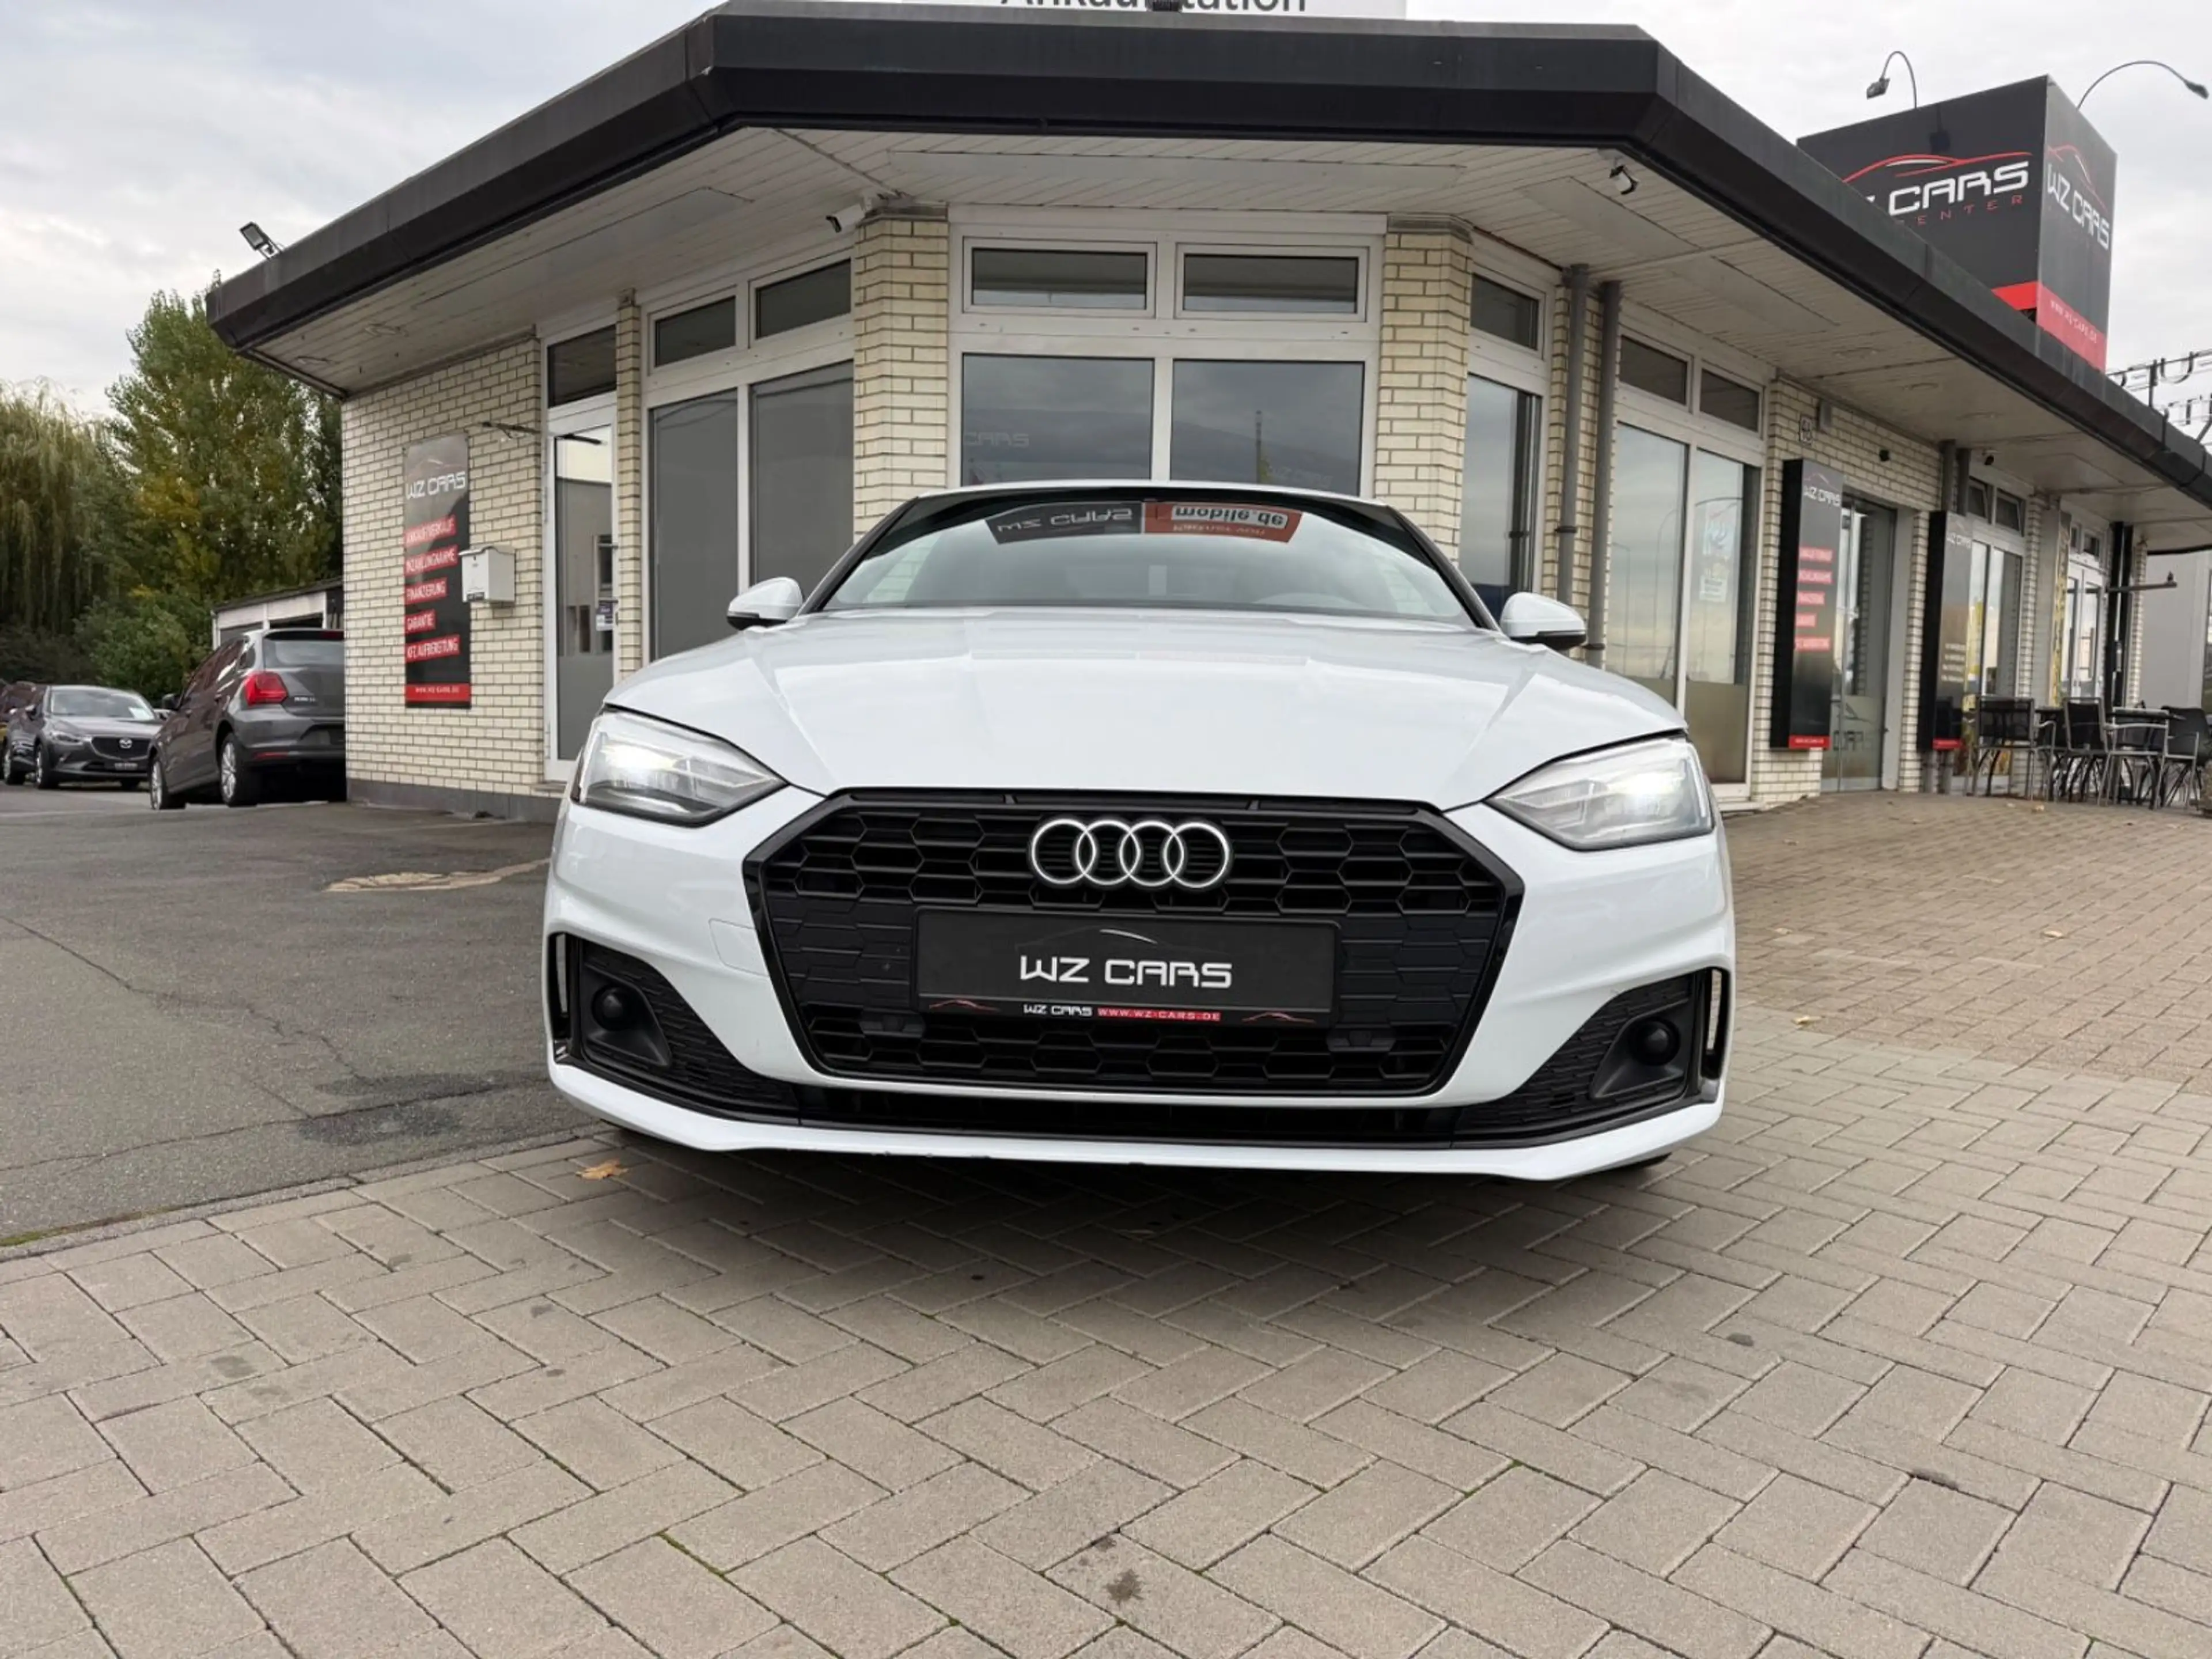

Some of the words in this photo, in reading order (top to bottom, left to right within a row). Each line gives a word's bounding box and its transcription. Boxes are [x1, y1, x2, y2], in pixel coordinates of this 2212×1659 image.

[1889, 161, 2029, 217] CARS
[1895, 194, 2024, 226] ENTER
[2047, 164, 2070, 212] WZ
[2072, 190, 2109, 251] CARS
[406, 480, 425, 499] WZ
[427, 471, 466, 496] CARS
[1020, 956, 1090, 983] WZ
[1105, 959, 1233, 988] CARS
[1023, 1003, 1047, 1014] WZ
[1051, 1005, 1093, 1017] CARS
